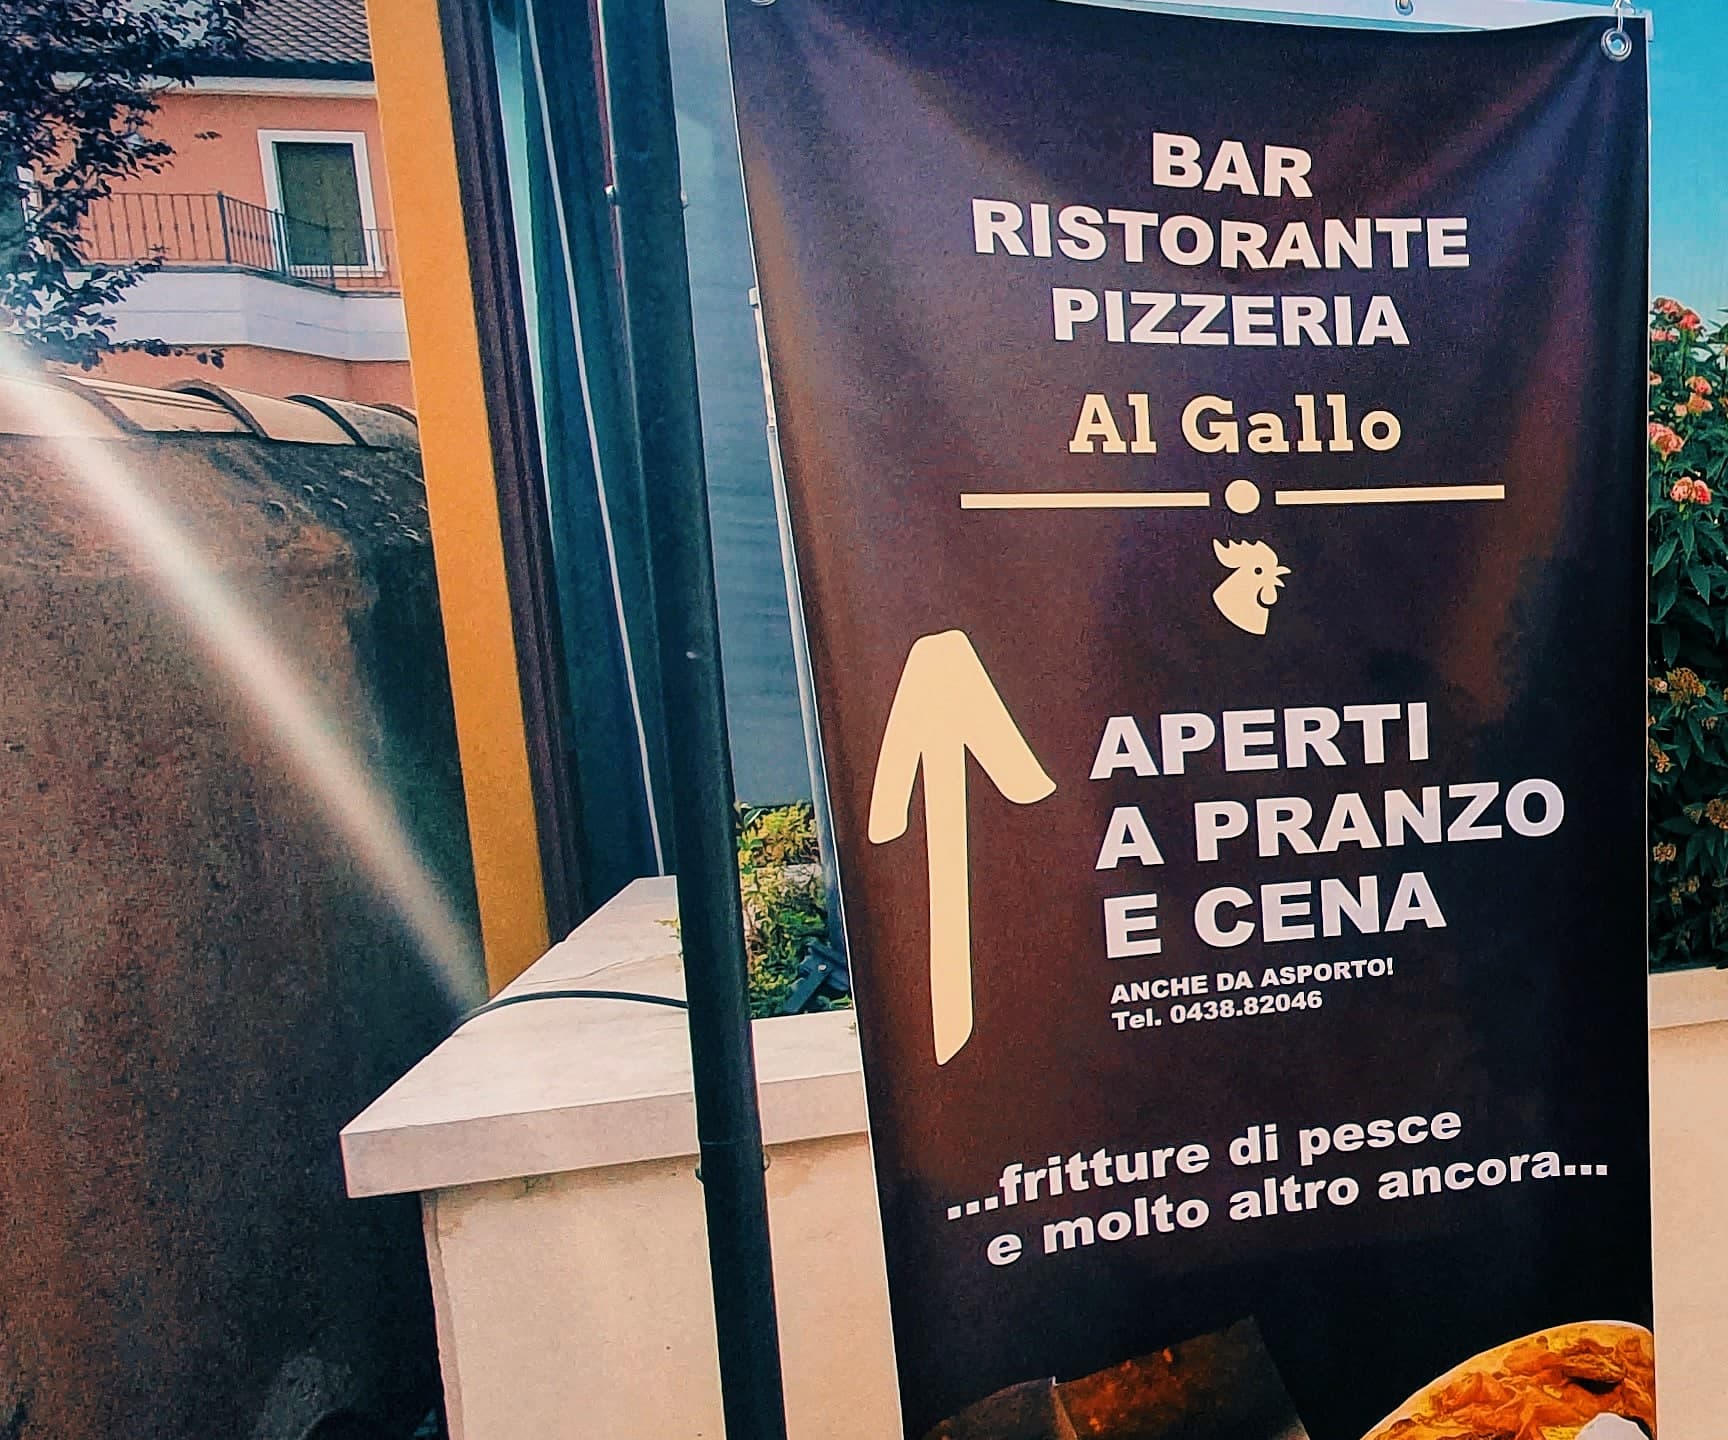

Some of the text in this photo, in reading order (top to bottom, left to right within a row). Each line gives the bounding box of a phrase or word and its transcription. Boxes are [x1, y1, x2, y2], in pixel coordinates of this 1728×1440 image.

[1153, 133, 1312, 197] BAR
[972, 199, 1469, 268] RISTORANTE
[1053, 288, 1409, 345] PIZZERIA
[1070, 394, 1401, 453] Al Gallo
[1090, 702, 1428, 779] APERTI
[1096, 779, 1564, 869] A PRANZO
[1104, 872, 1446, 958] E CENA
[1111, 958, 1393, 1004] ANCHE DA ASPORTO!
[1112, 991, 1322, 1030] Tel. 0438.82046
[948, 1112, 1461, 1220] ...fritture di pesce
[988, 1152, 1607, 1265] e molto altro ancora...
